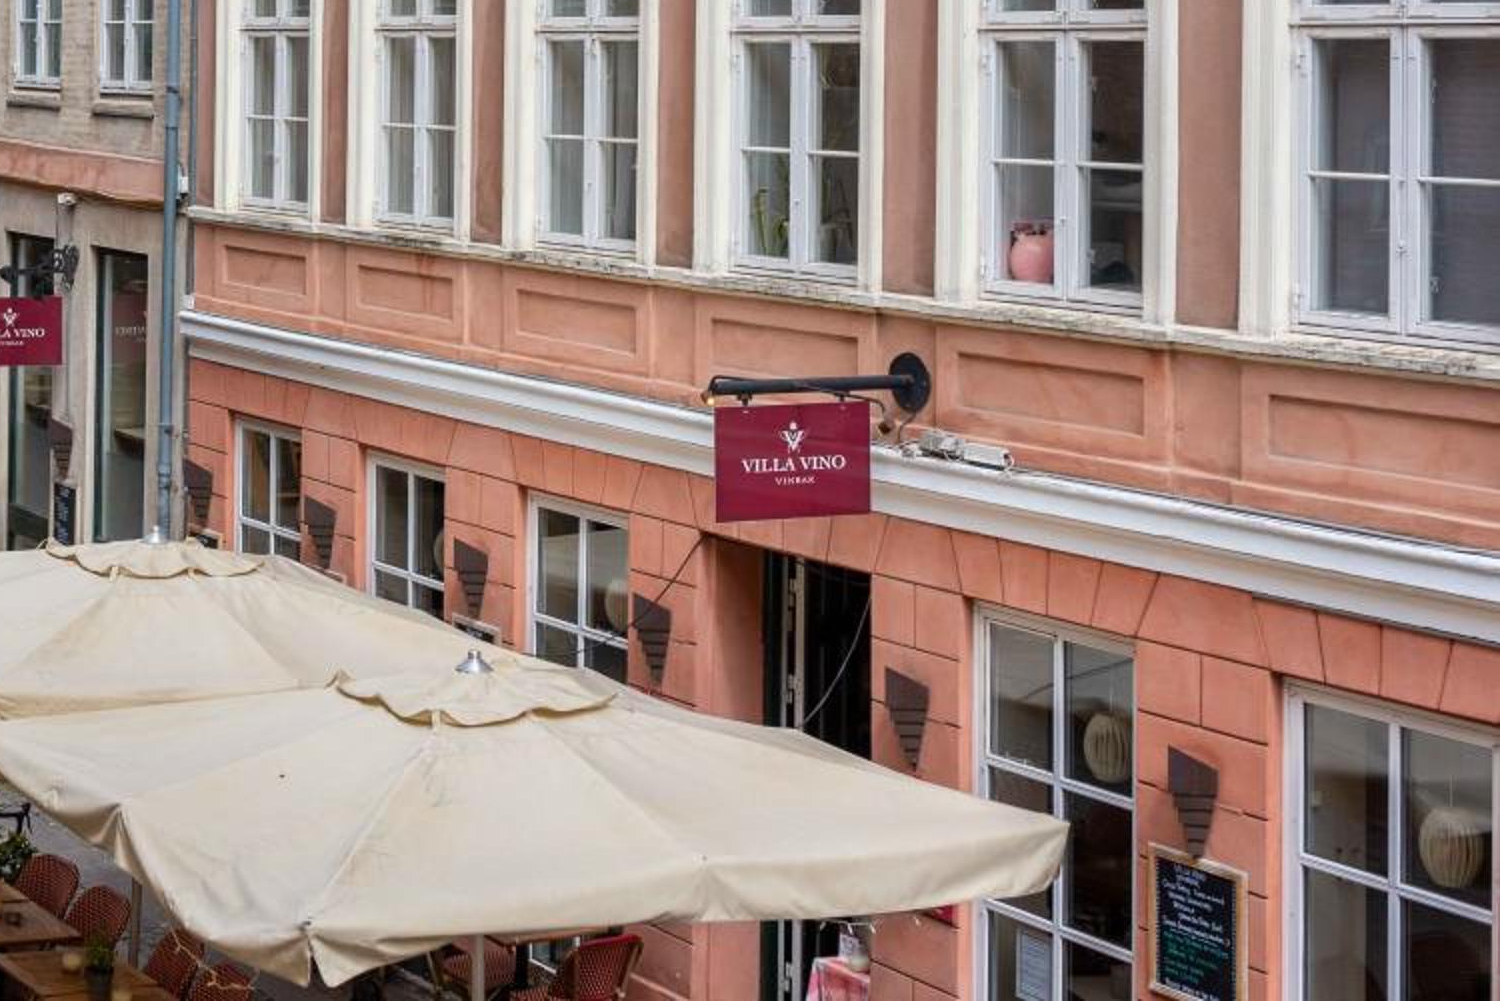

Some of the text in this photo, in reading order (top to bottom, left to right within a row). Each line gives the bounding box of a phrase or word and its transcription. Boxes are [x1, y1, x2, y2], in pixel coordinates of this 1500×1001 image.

[13, 327, 46, 339] VINO
[741, 454, 847, 474] VILLA VINO
